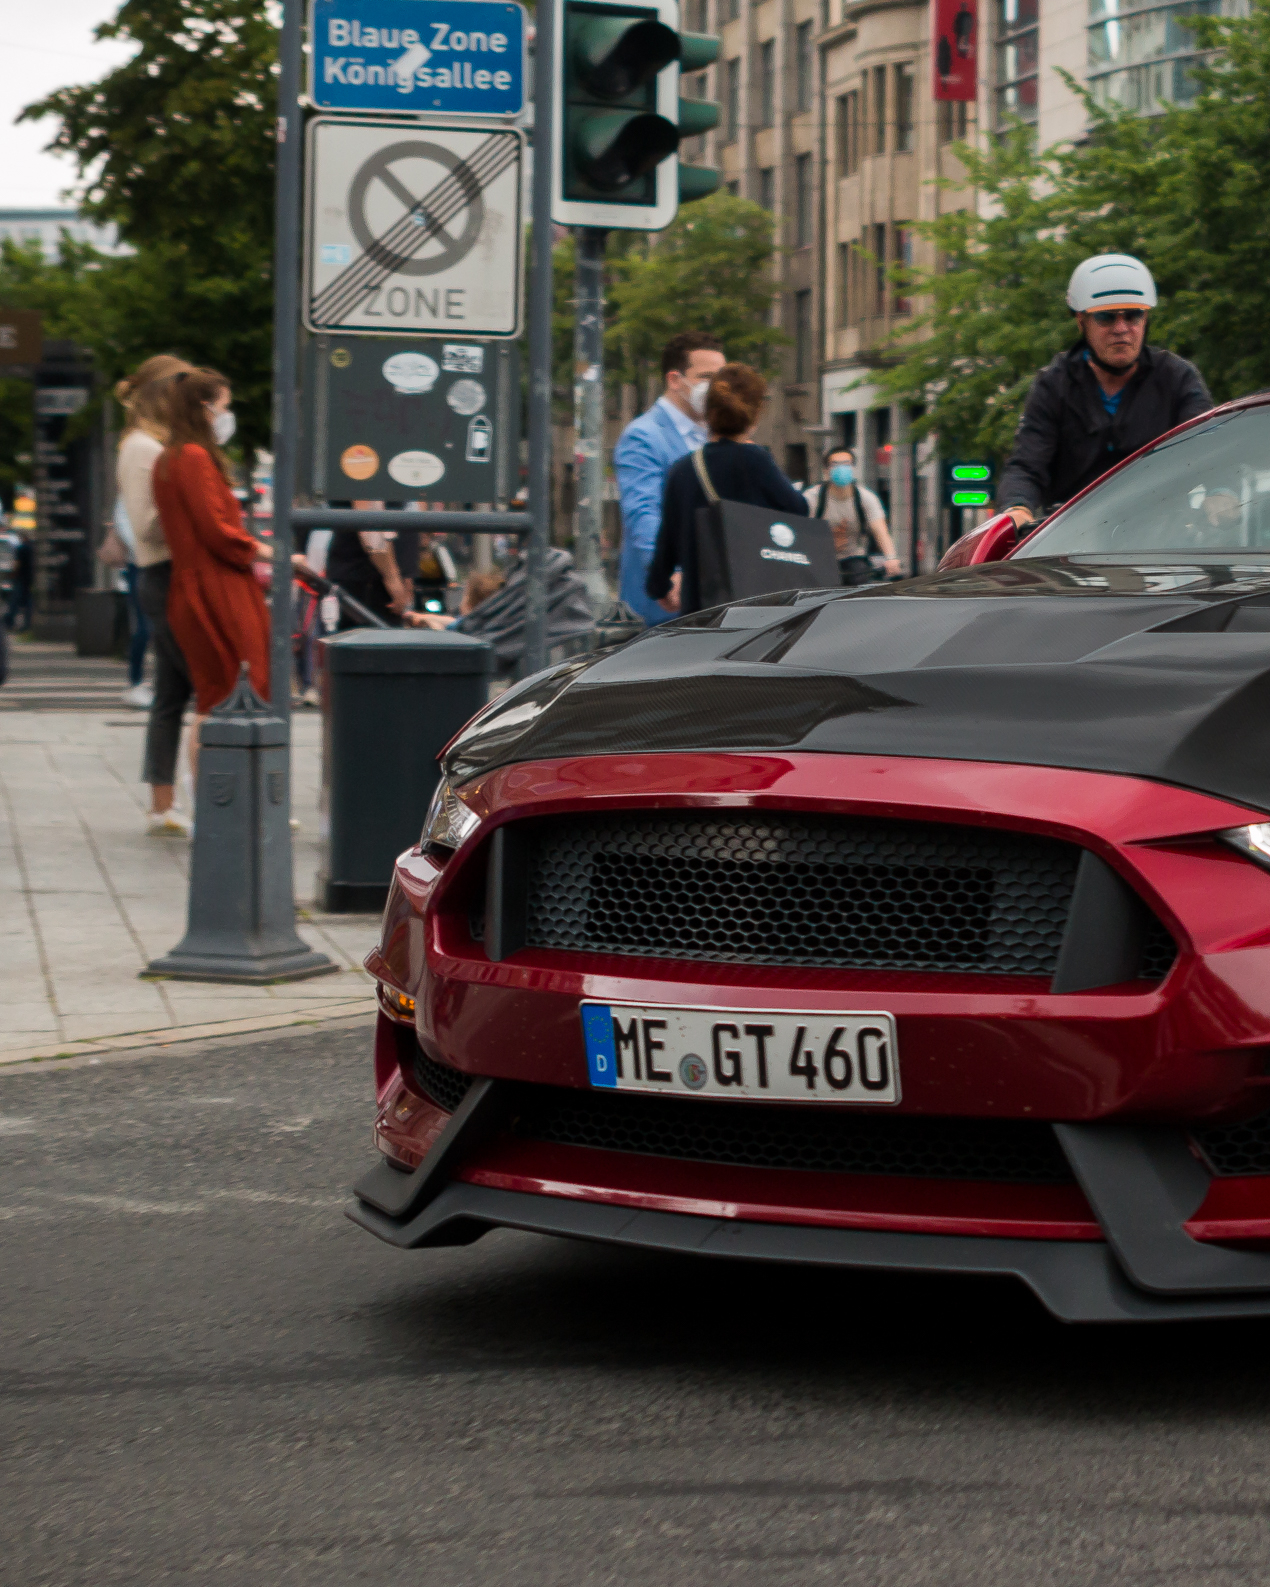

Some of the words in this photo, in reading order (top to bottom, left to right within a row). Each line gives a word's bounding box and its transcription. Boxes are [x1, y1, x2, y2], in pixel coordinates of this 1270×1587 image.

[328, 18, 420, 49] Blaue
[429, 23, 508, 53] Zone
[362, 284, 465, 320] ZONE
[596, 1055, 607, 1072] D
[612, 1015, 673, 1083] ME
[712, 1021, 774, 1089] GT
[788, 1025, 889, 1091] 460
